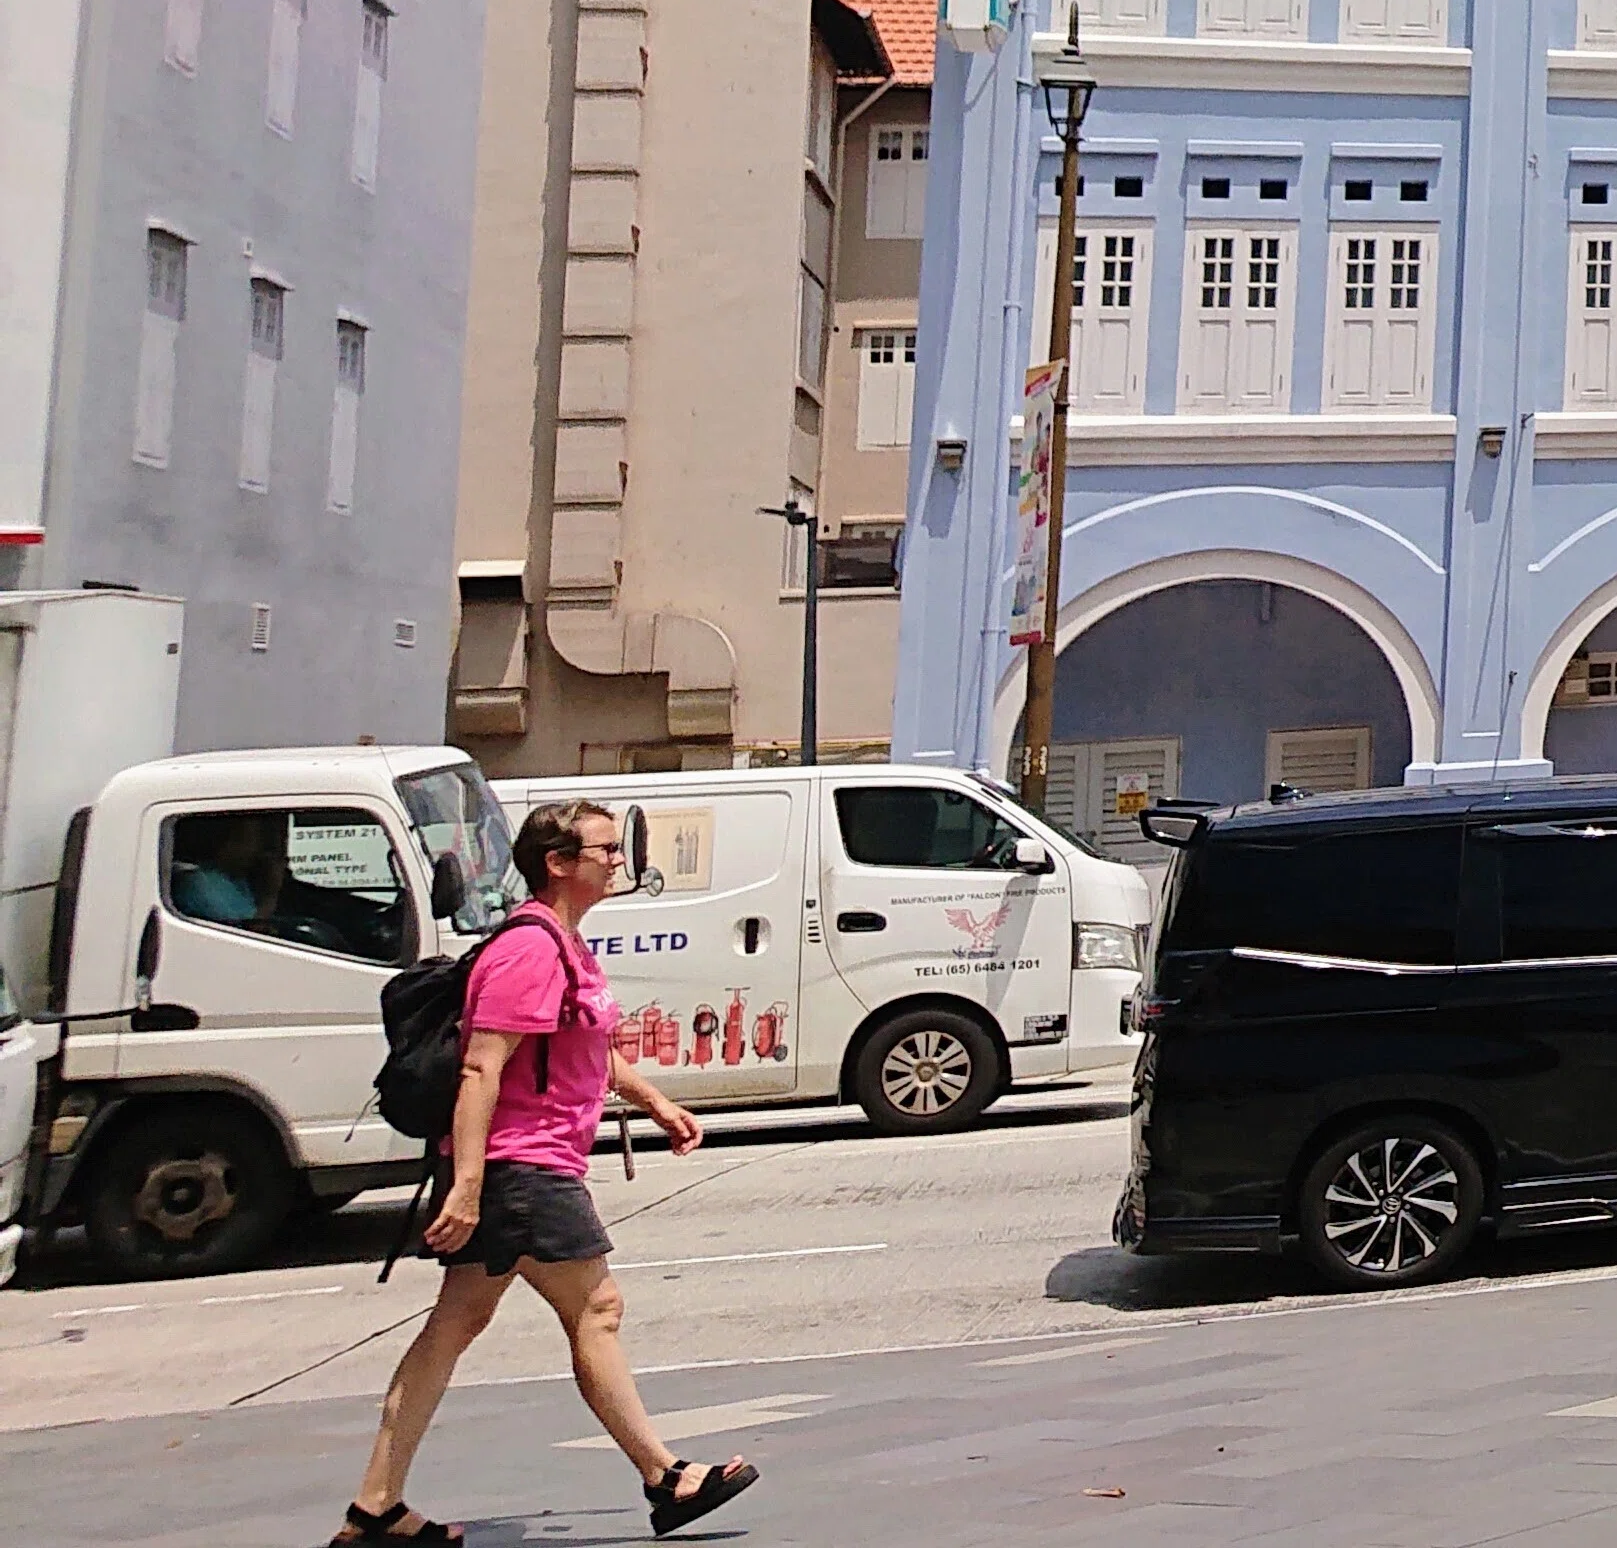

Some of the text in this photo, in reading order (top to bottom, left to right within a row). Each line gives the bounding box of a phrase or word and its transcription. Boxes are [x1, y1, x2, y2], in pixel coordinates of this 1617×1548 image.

[296, 828, 377, 840] SYSTEM 21
[311, 853, 352, 862] PANEL
[335, 864, 368, 874] TYPE
[890, 894, 954, 905] MANUFACTURER
[955, 893, 965, 901] OF
[1025, 886, 1066, 896] PRODUCTS
[587, 932, 688, 955] TE LTD
[915, 959, 1041, 976] TEL: (65) 6484 1201
